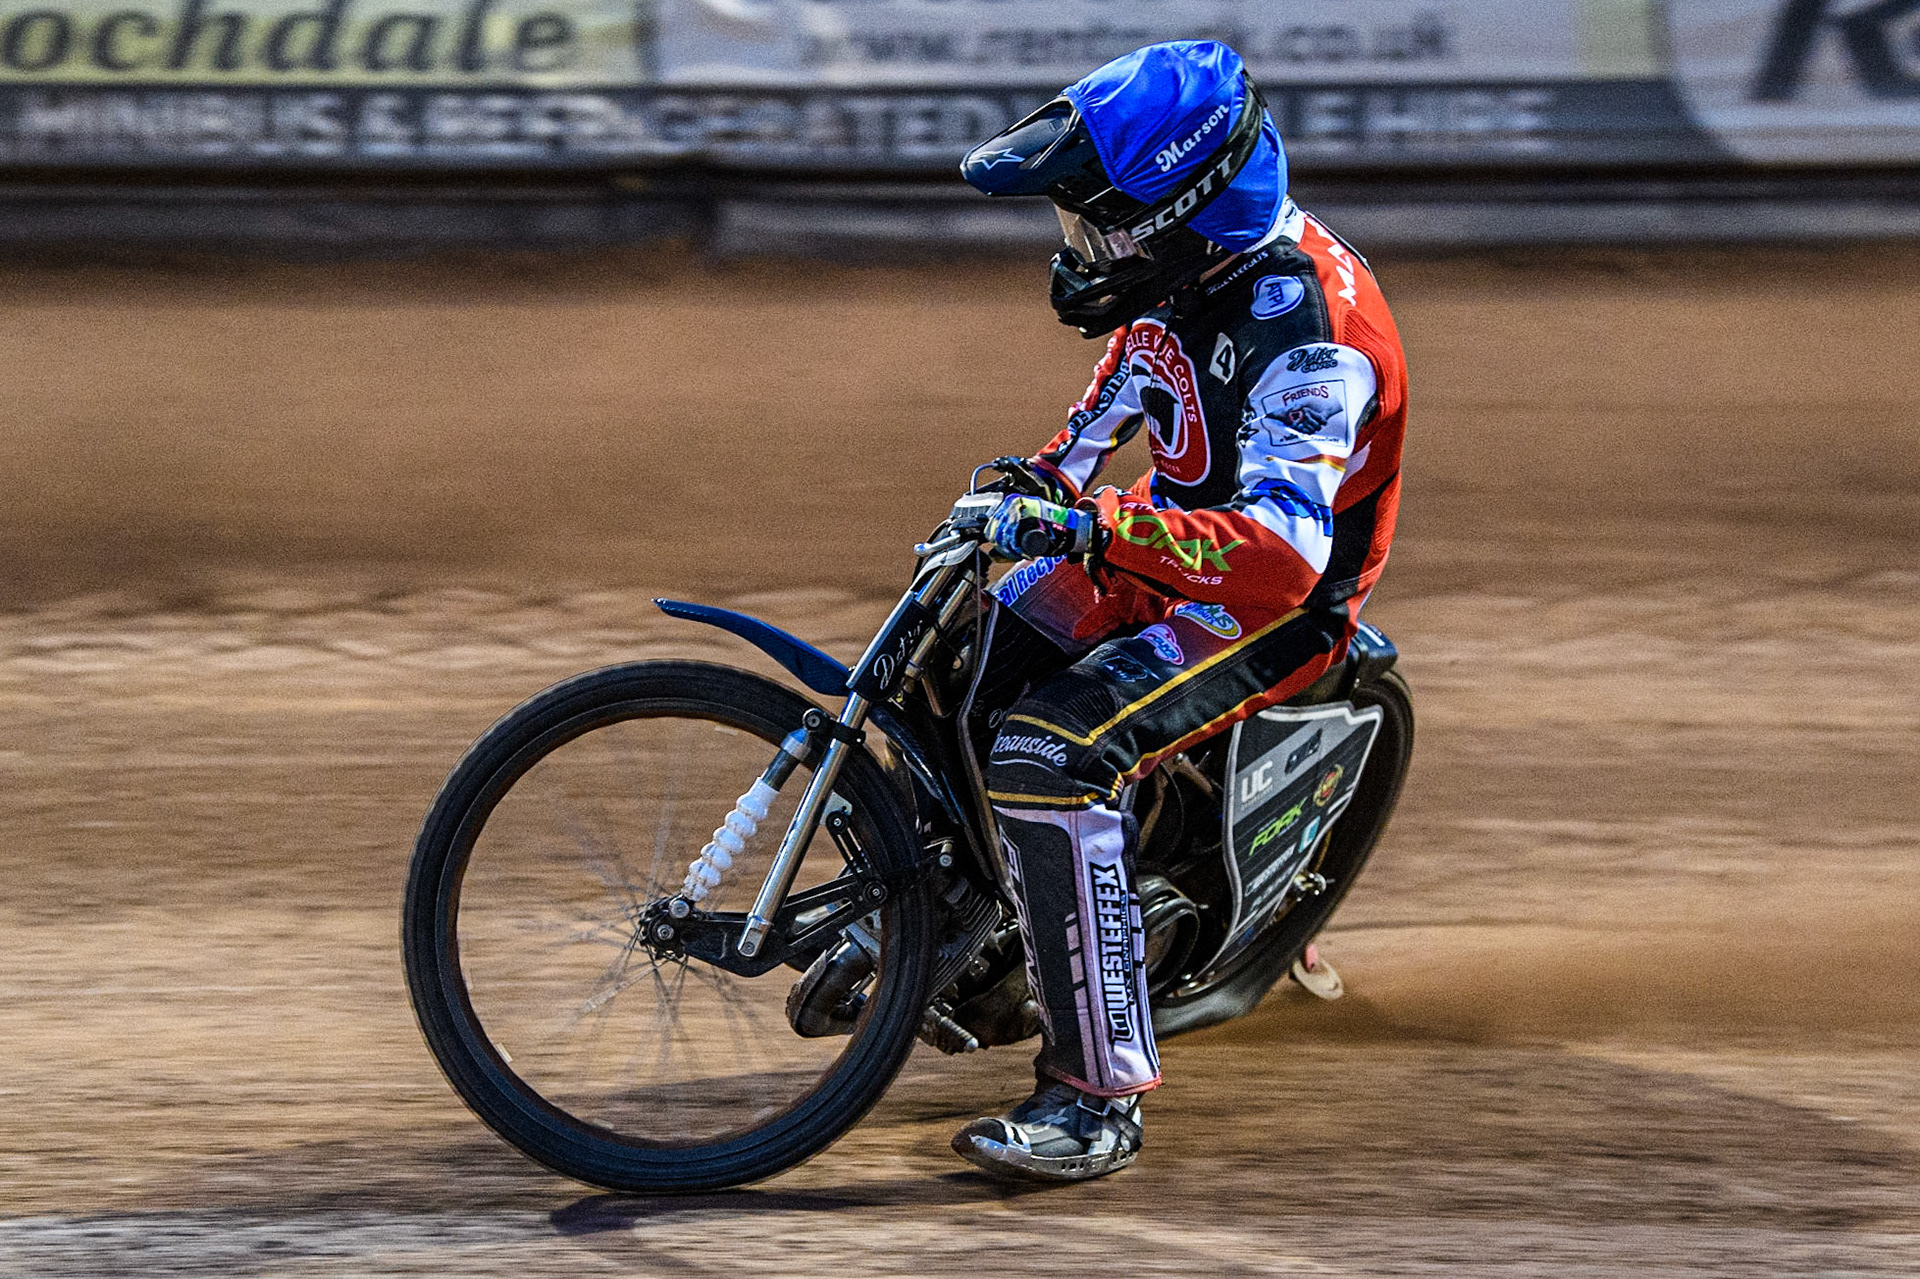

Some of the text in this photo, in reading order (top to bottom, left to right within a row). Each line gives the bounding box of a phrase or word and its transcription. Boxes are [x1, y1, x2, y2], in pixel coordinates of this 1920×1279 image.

[1155, 104, 1230, 172] Marson
[1130, 152, 1233, 243] SCOTT
[1173, 364, 1198, 424] COLTS
[1282, 385, 1329, 407] FRIENDS
[990, 731, 1068, 767] ceanside
[1093, 864, 1129, 1011] WESTEFFEX
